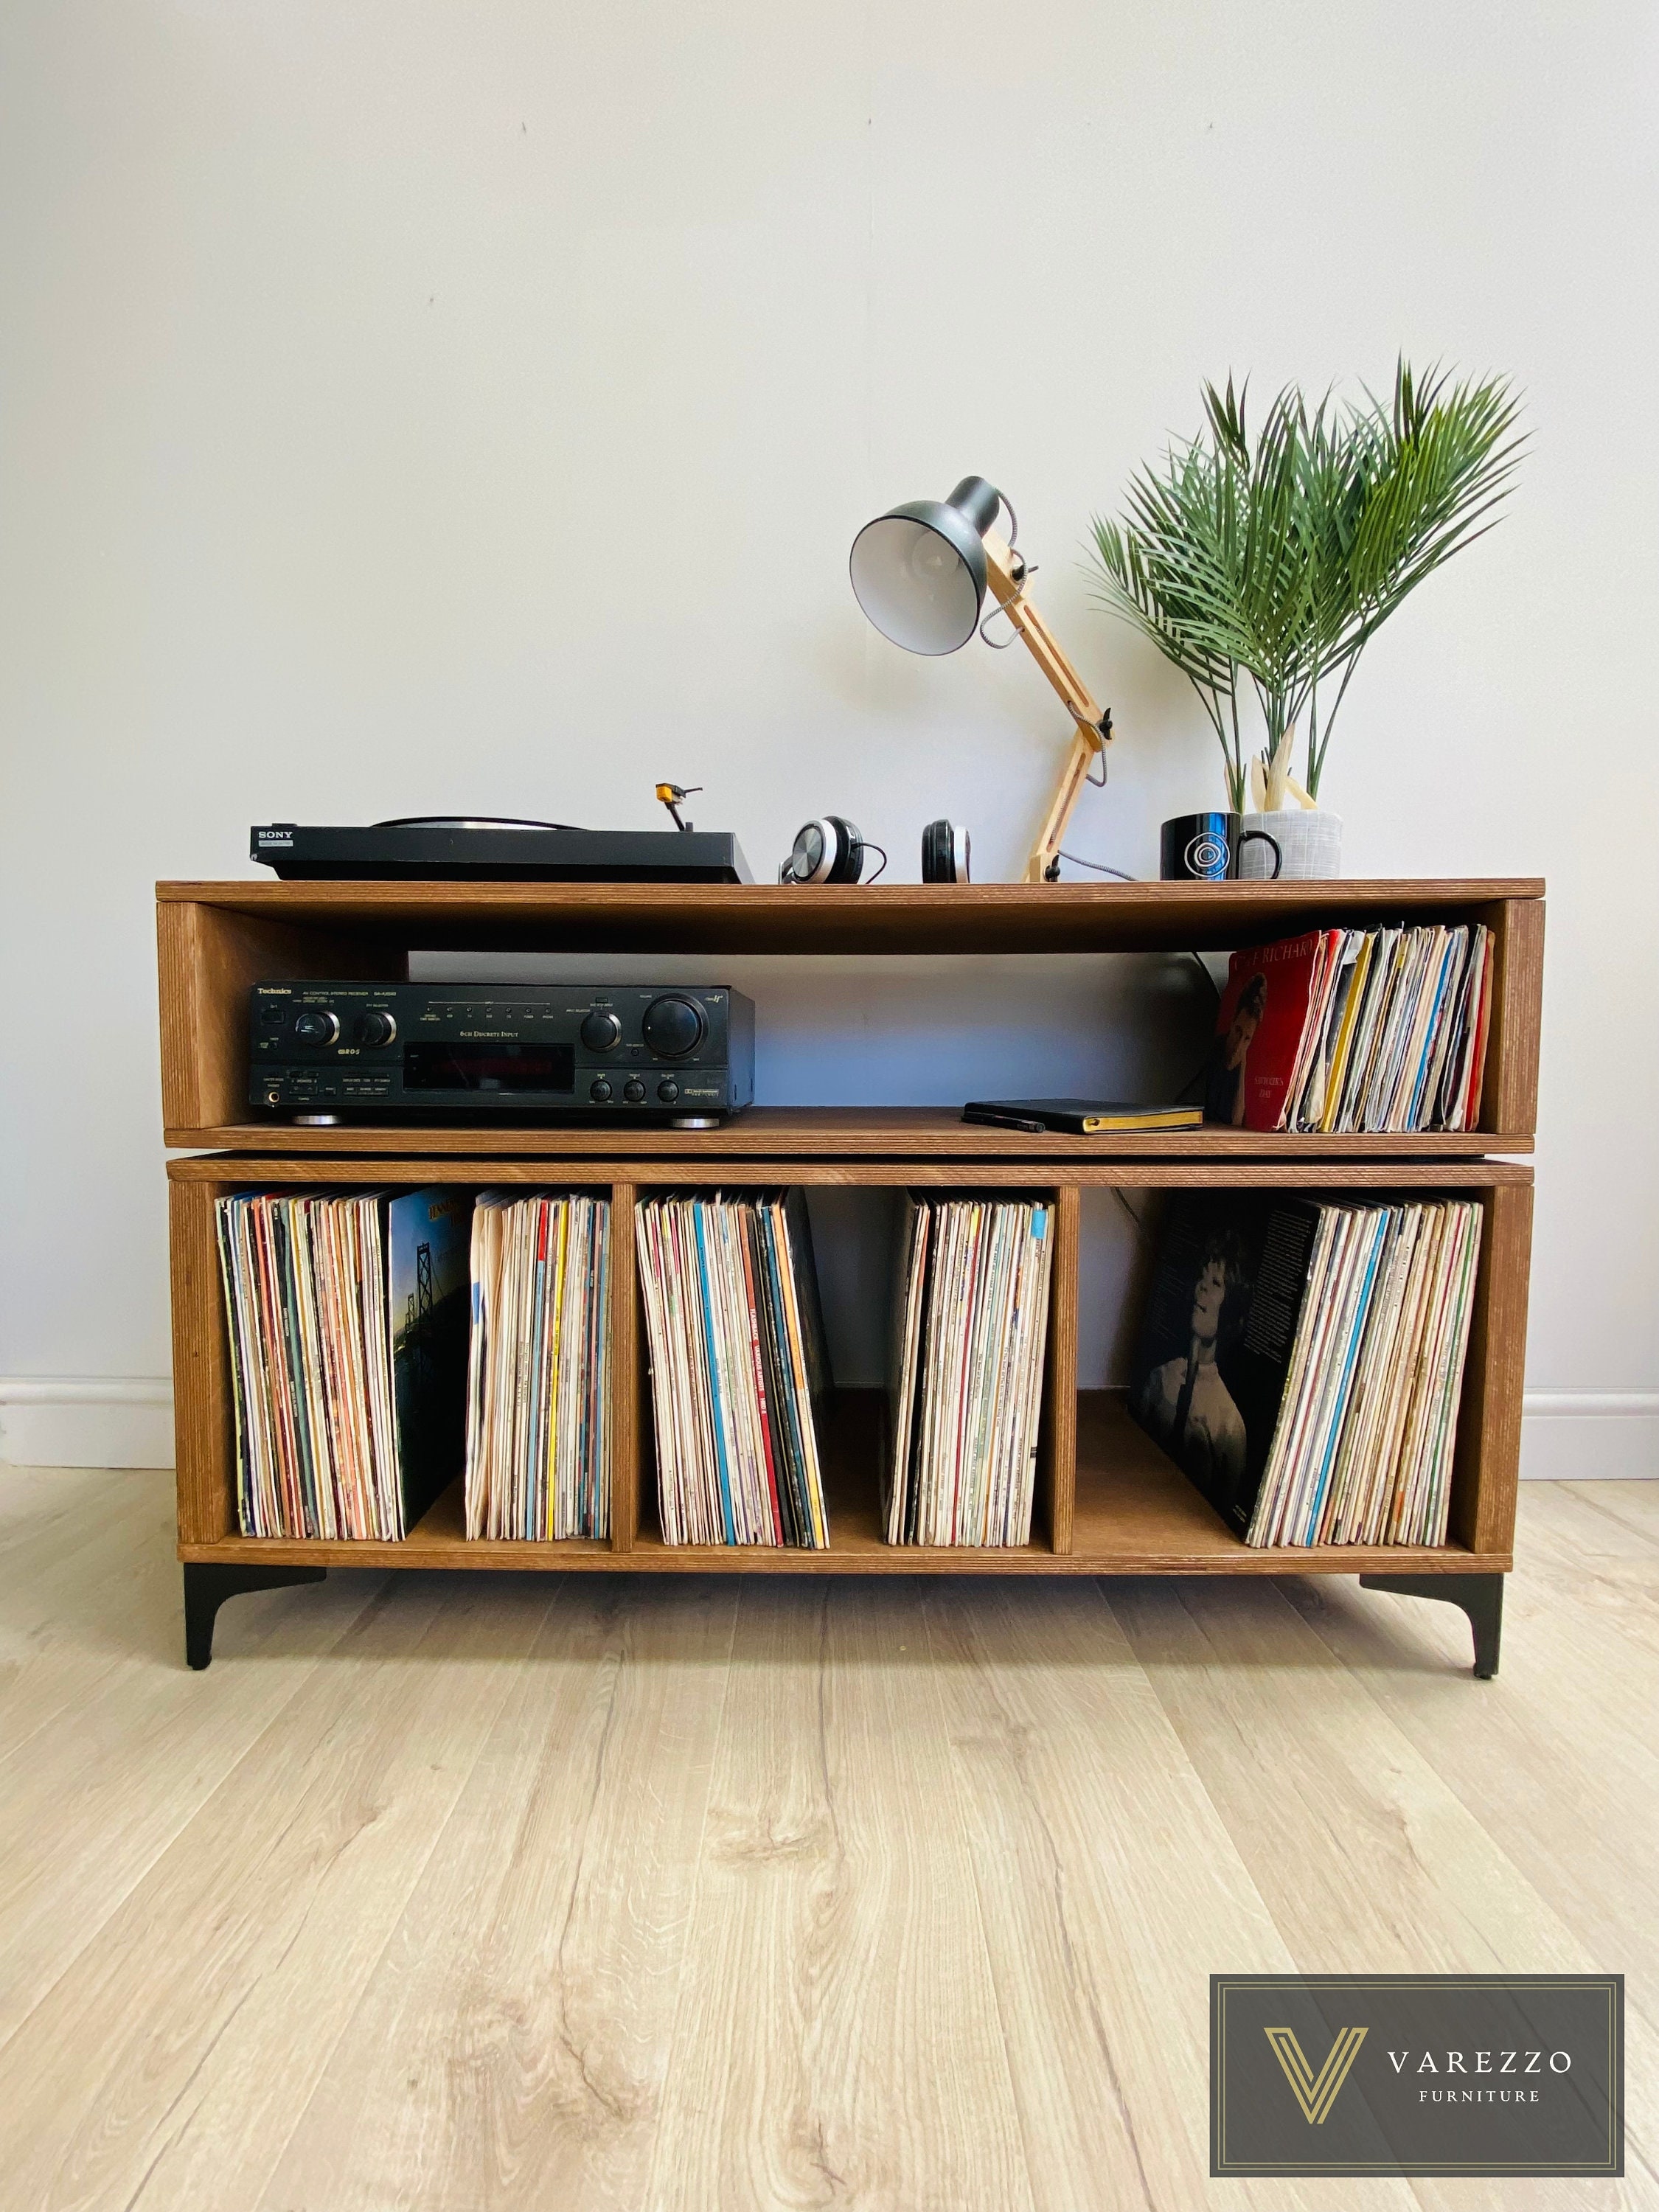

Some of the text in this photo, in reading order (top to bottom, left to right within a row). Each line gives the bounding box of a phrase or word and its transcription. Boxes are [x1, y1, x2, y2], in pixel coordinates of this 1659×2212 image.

[749, 1308, 759, 1340] FLASHBACK
[754, 1344, 762, 1370] VARIOUS
[757, 1370, 765, 1391] ARTISTS
